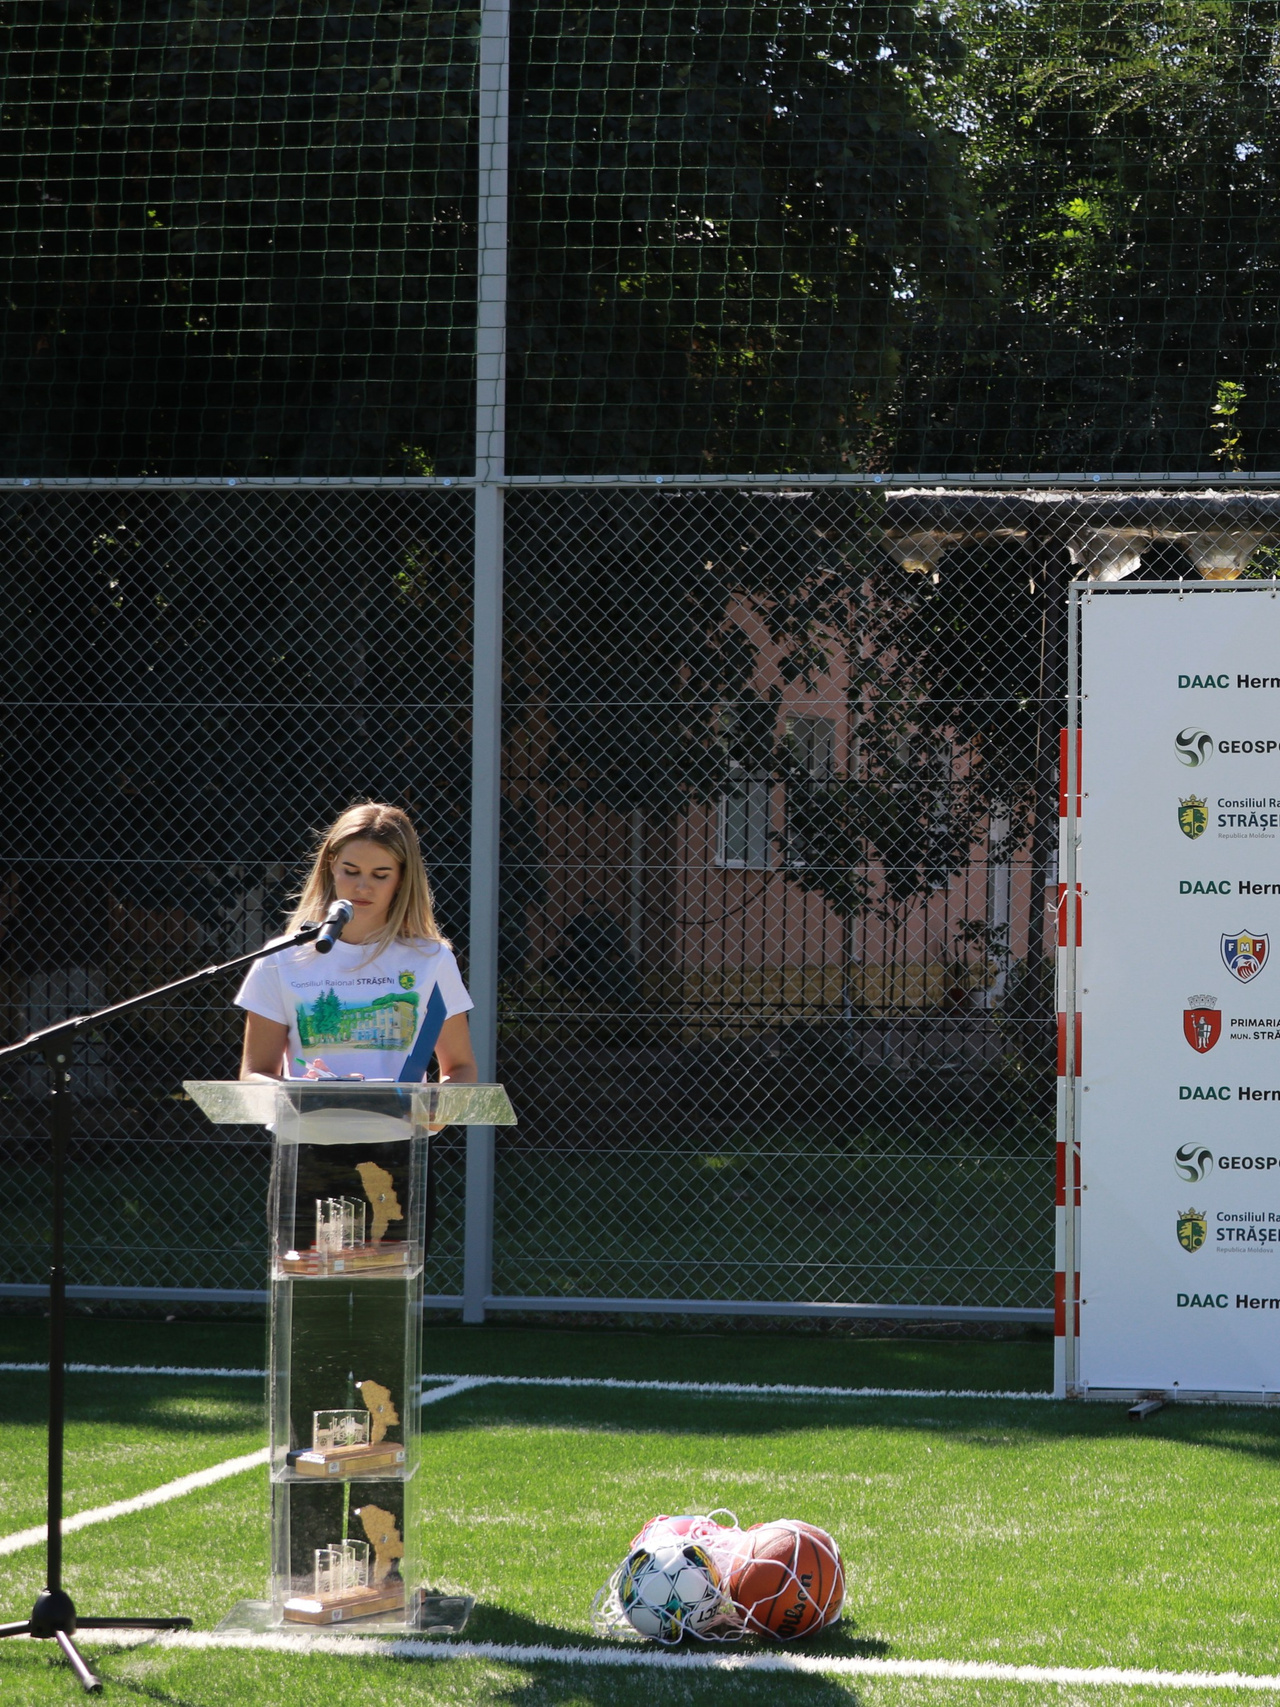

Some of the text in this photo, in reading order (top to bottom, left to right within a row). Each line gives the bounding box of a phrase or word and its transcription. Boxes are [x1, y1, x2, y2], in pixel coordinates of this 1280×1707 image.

[1177, 673, 1230, 689] DAAC
[1217, 797, 1267, 809] Consiliul
[1179, 880, 1232, 896] DAAC
[325, 979, 355, 987] Raional
[1229, 1032, 1252, 1041] MUN.
[1178, 1085, 1232, 1101] DAAC
[1216, 1211, 1266, 1223] Consiliul
[1176, 1292, 1229, 1309] DAAC
